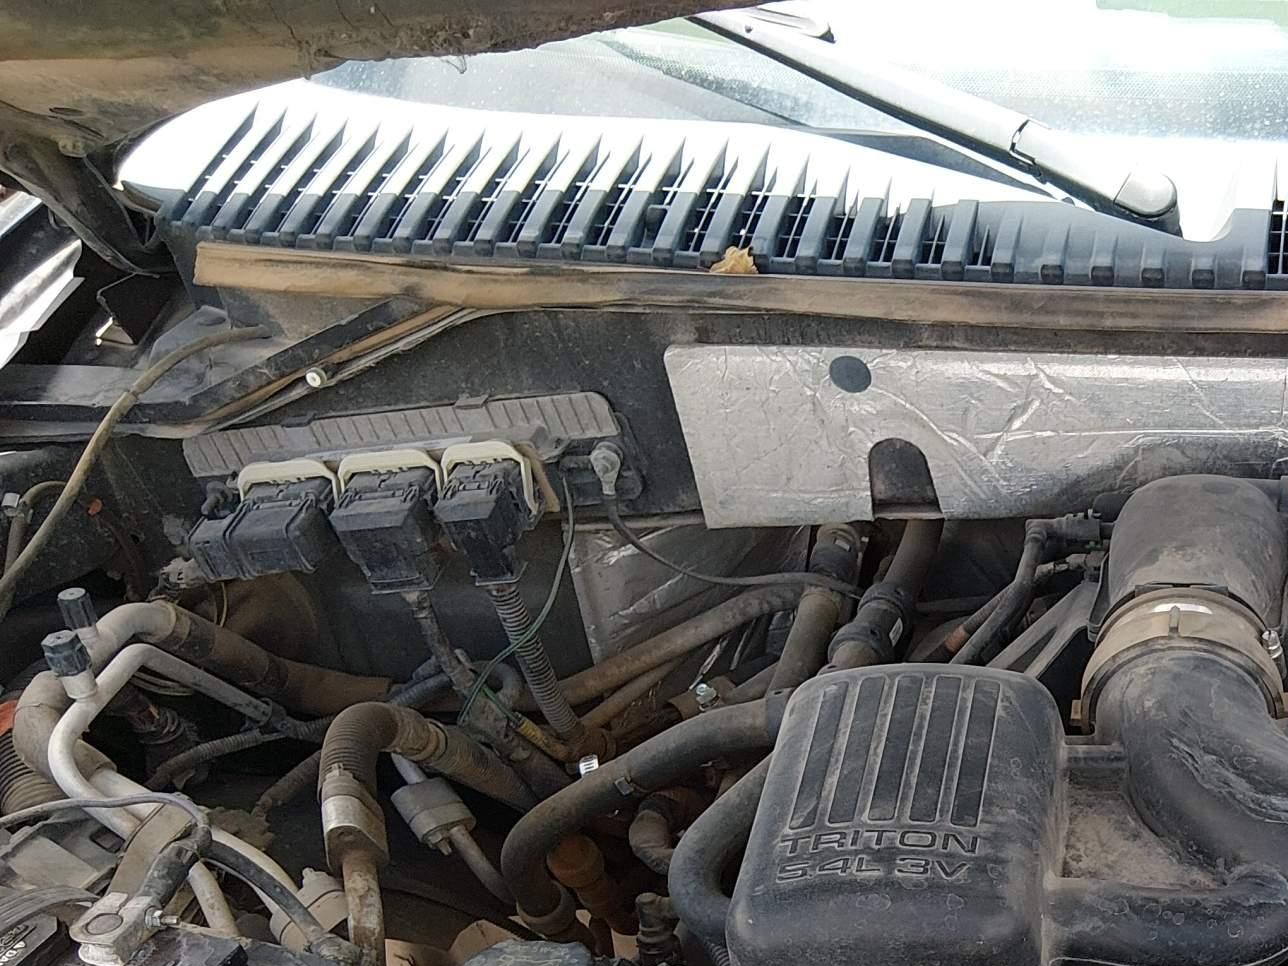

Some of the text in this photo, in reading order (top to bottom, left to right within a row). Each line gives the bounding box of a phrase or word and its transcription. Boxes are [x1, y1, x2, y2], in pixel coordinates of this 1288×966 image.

[780, 830, 979, 855] TRITON
[776, 857, 970, 883] 5.4L 3V
